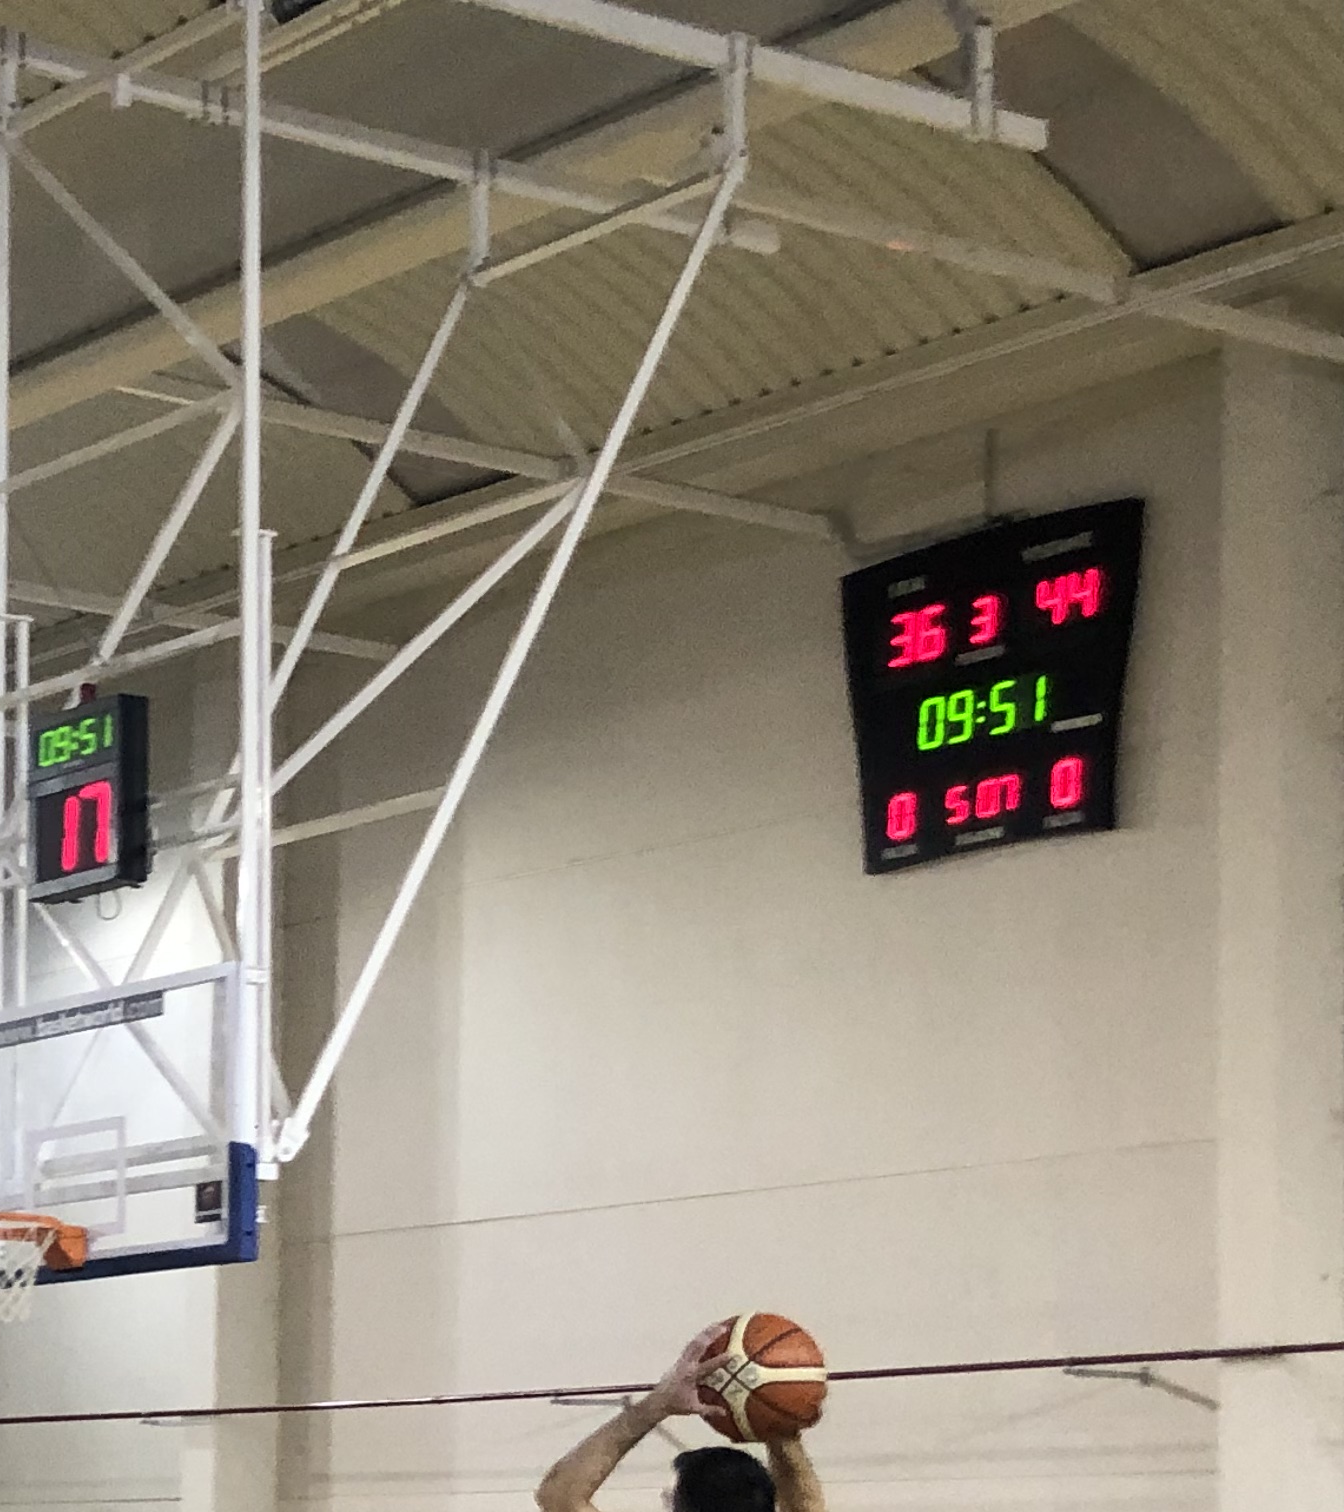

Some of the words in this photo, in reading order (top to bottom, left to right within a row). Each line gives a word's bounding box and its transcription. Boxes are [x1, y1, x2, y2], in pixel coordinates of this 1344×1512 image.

[888, 603, 946, 667] 36
[970, 594, 999, 645] 3
[1036, 567, 1102, 625] 44
[917, 674, 1048, 751] 09:51
[885, 792, 918, 842] 0
[1049, 757, 1084, 809] 0
